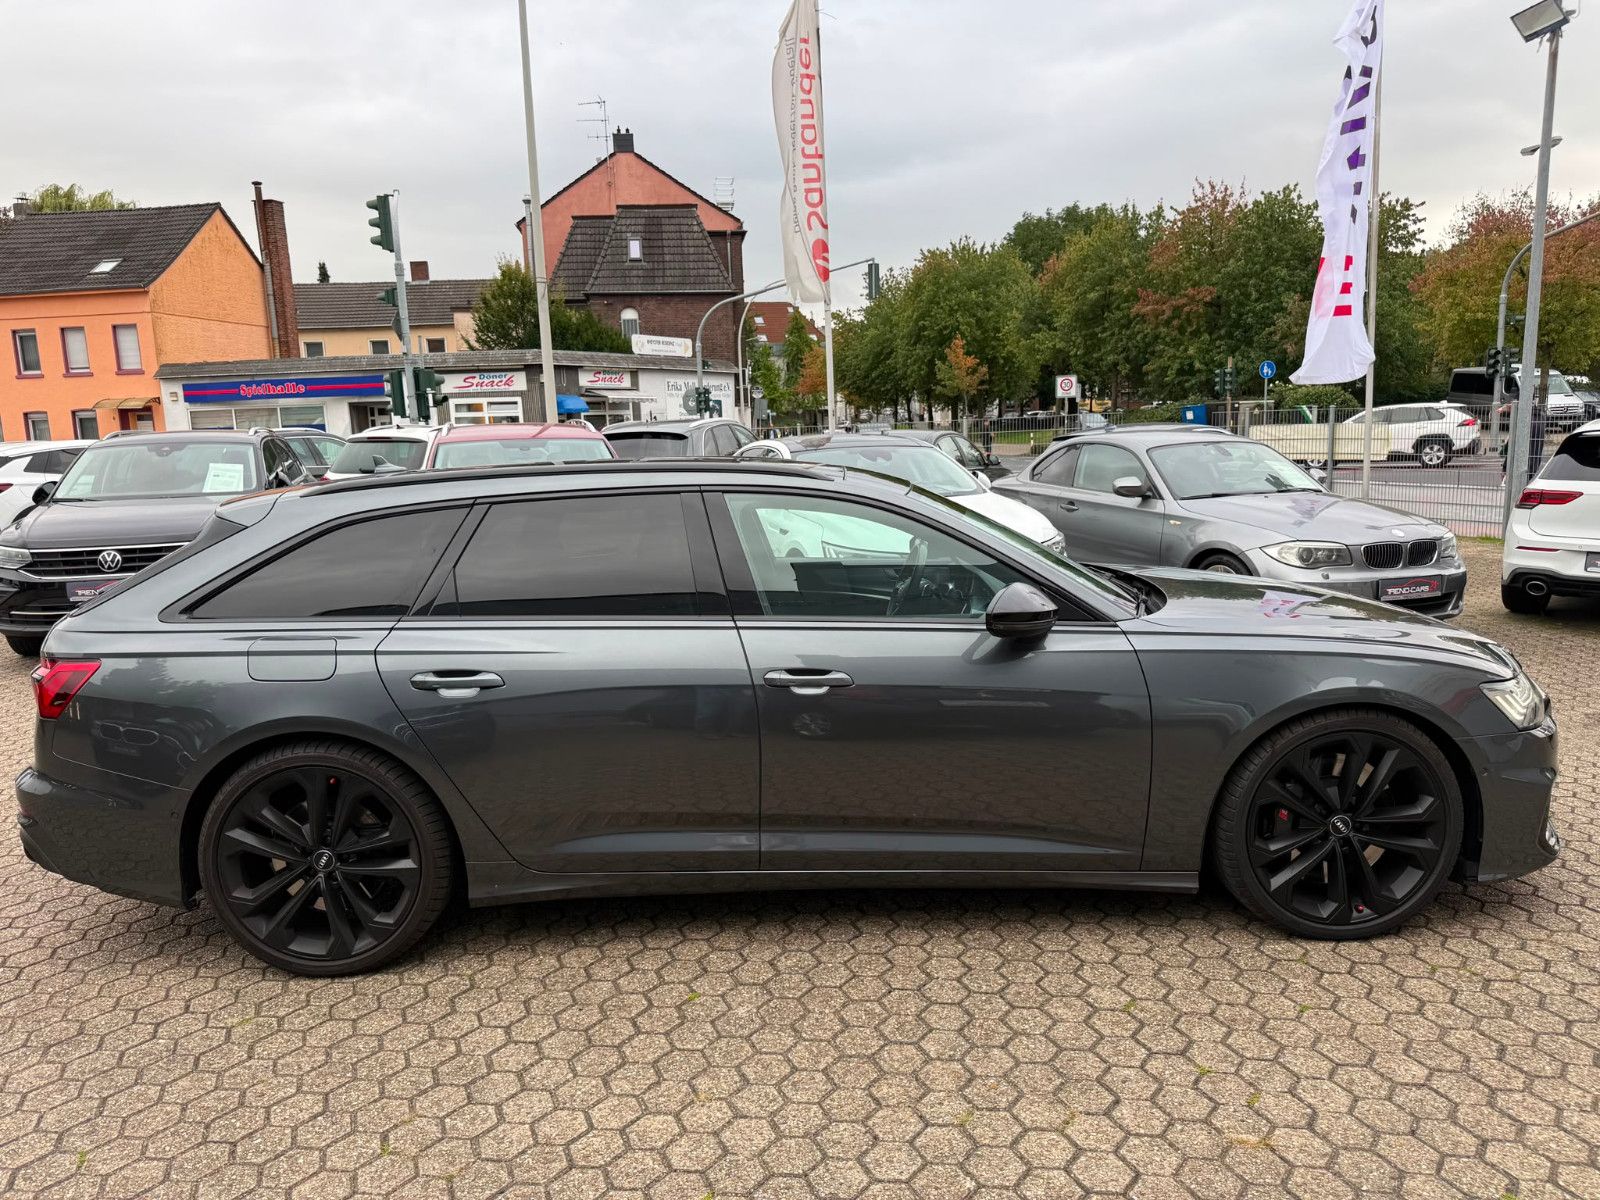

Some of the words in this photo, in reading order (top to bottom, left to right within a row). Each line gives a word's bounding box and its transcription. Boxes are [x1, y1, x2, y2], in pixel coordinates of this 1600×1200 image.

[453, 375, 515, 389] Snack
[586, 370, 624, 384] Snack
[240, 382, 305, 397] Spielhalle
